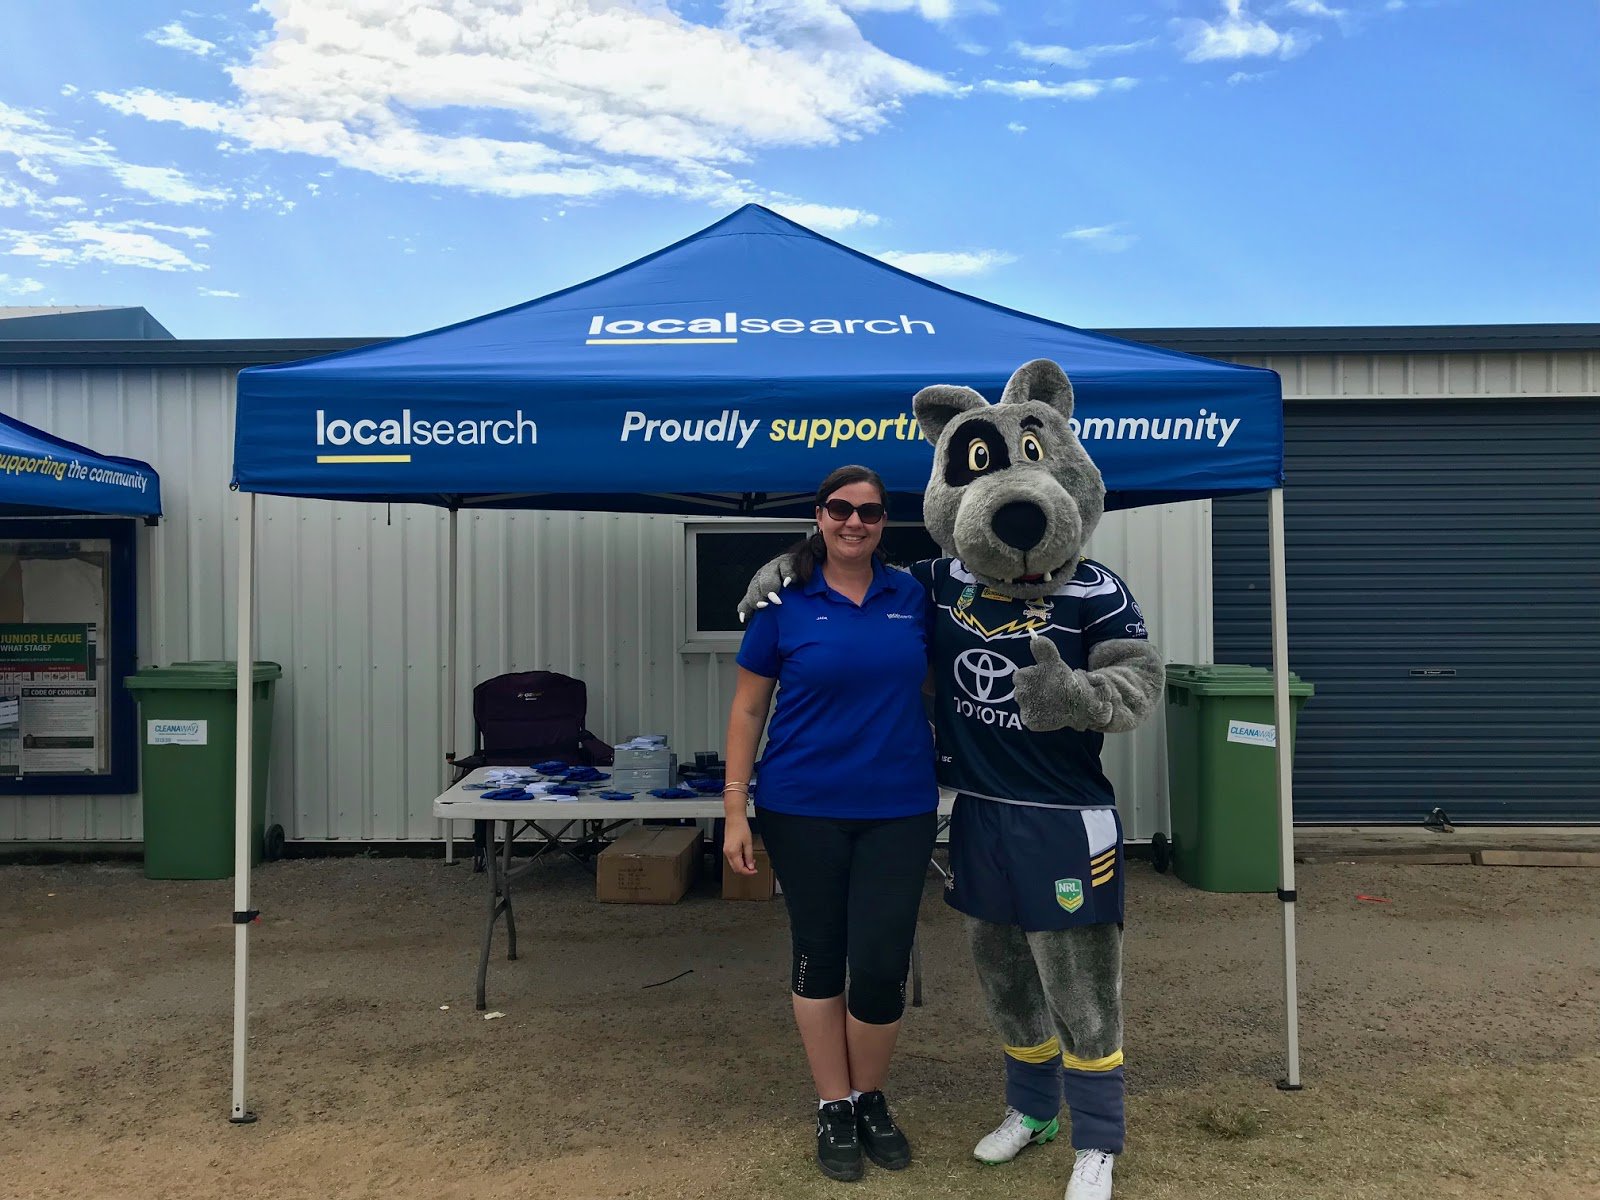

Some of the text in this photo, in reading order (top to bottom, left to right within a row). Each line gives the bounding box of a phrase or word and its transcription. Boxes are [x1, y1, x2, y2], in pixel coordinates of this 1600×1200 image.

[588, 312, 936, 335] localsearch
[316, 408, 538, 446] localsearch
[620, 409, 926, 449] Proudly supporti
[1067, 408, 1241, 448] ommunity
[0, 453, 148, 493] upporting the community
[0, 634, 82, 644] JUNIOR LEAGUE
[0, 644, 52, 652] WHAT STAGE?
[953, 696, 1023, 731] TOYOTA
[154, 725, 197, 733] CLEANAWAY
[1058, 882, 1080, 893] NRL
